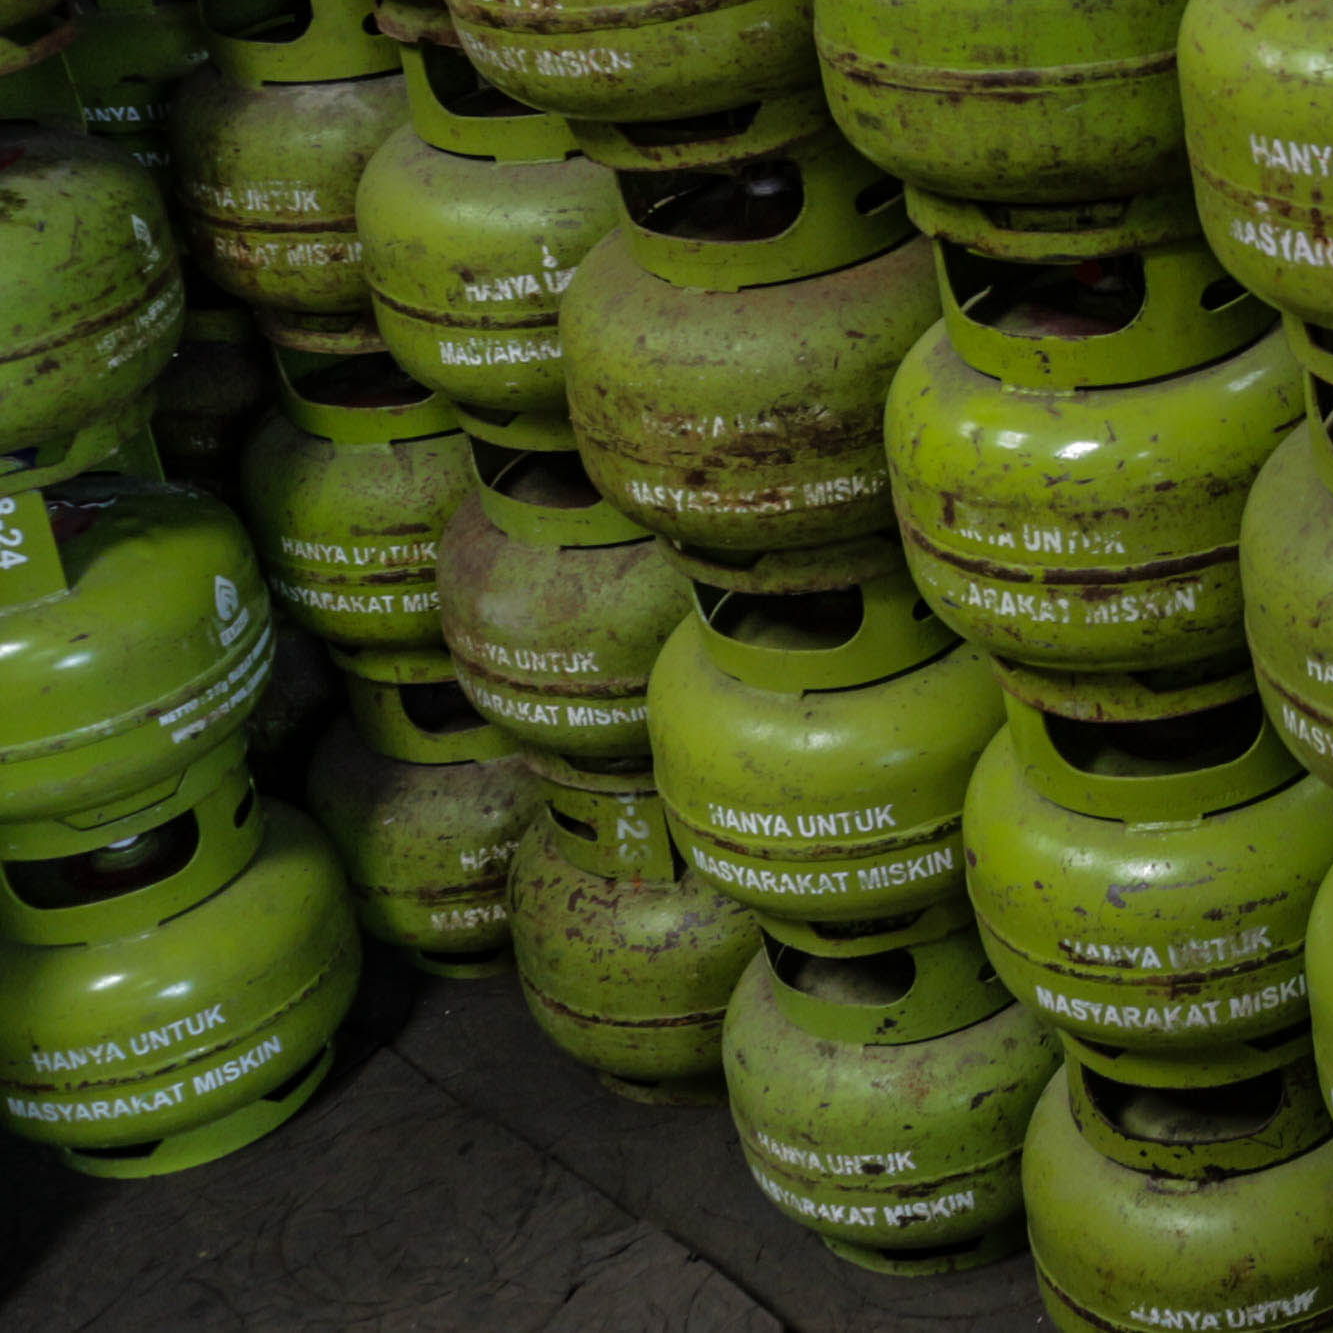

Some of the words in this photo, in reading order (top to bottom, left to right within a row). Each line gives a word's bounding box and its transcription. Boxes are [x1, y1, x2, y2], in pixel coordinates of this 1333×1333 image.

[281, 536, 349, 565] HANYA
[514, 650, 601, 674] UNTUK
[708, 802, 793, 839] HANYA
[797, 803, 897, 840] UNTUK
[692, 846, 850, 897] MASYARAKAT
[857, 847, 954, 893] MISKIN
[1035, 985, 1222, 1032] MASYARAKAT
[1229, 974, 1307, 1019] MISKI
[31, 1041, 127, 1074] HANYA
[129, 1003, 227, 1057] UNTUK
[6, 1081, 188, 1123] MASYARAKAT
[192, 1034, 284, 1097] MISKIN
[883, 1189, 976, 1226] MISKIN
